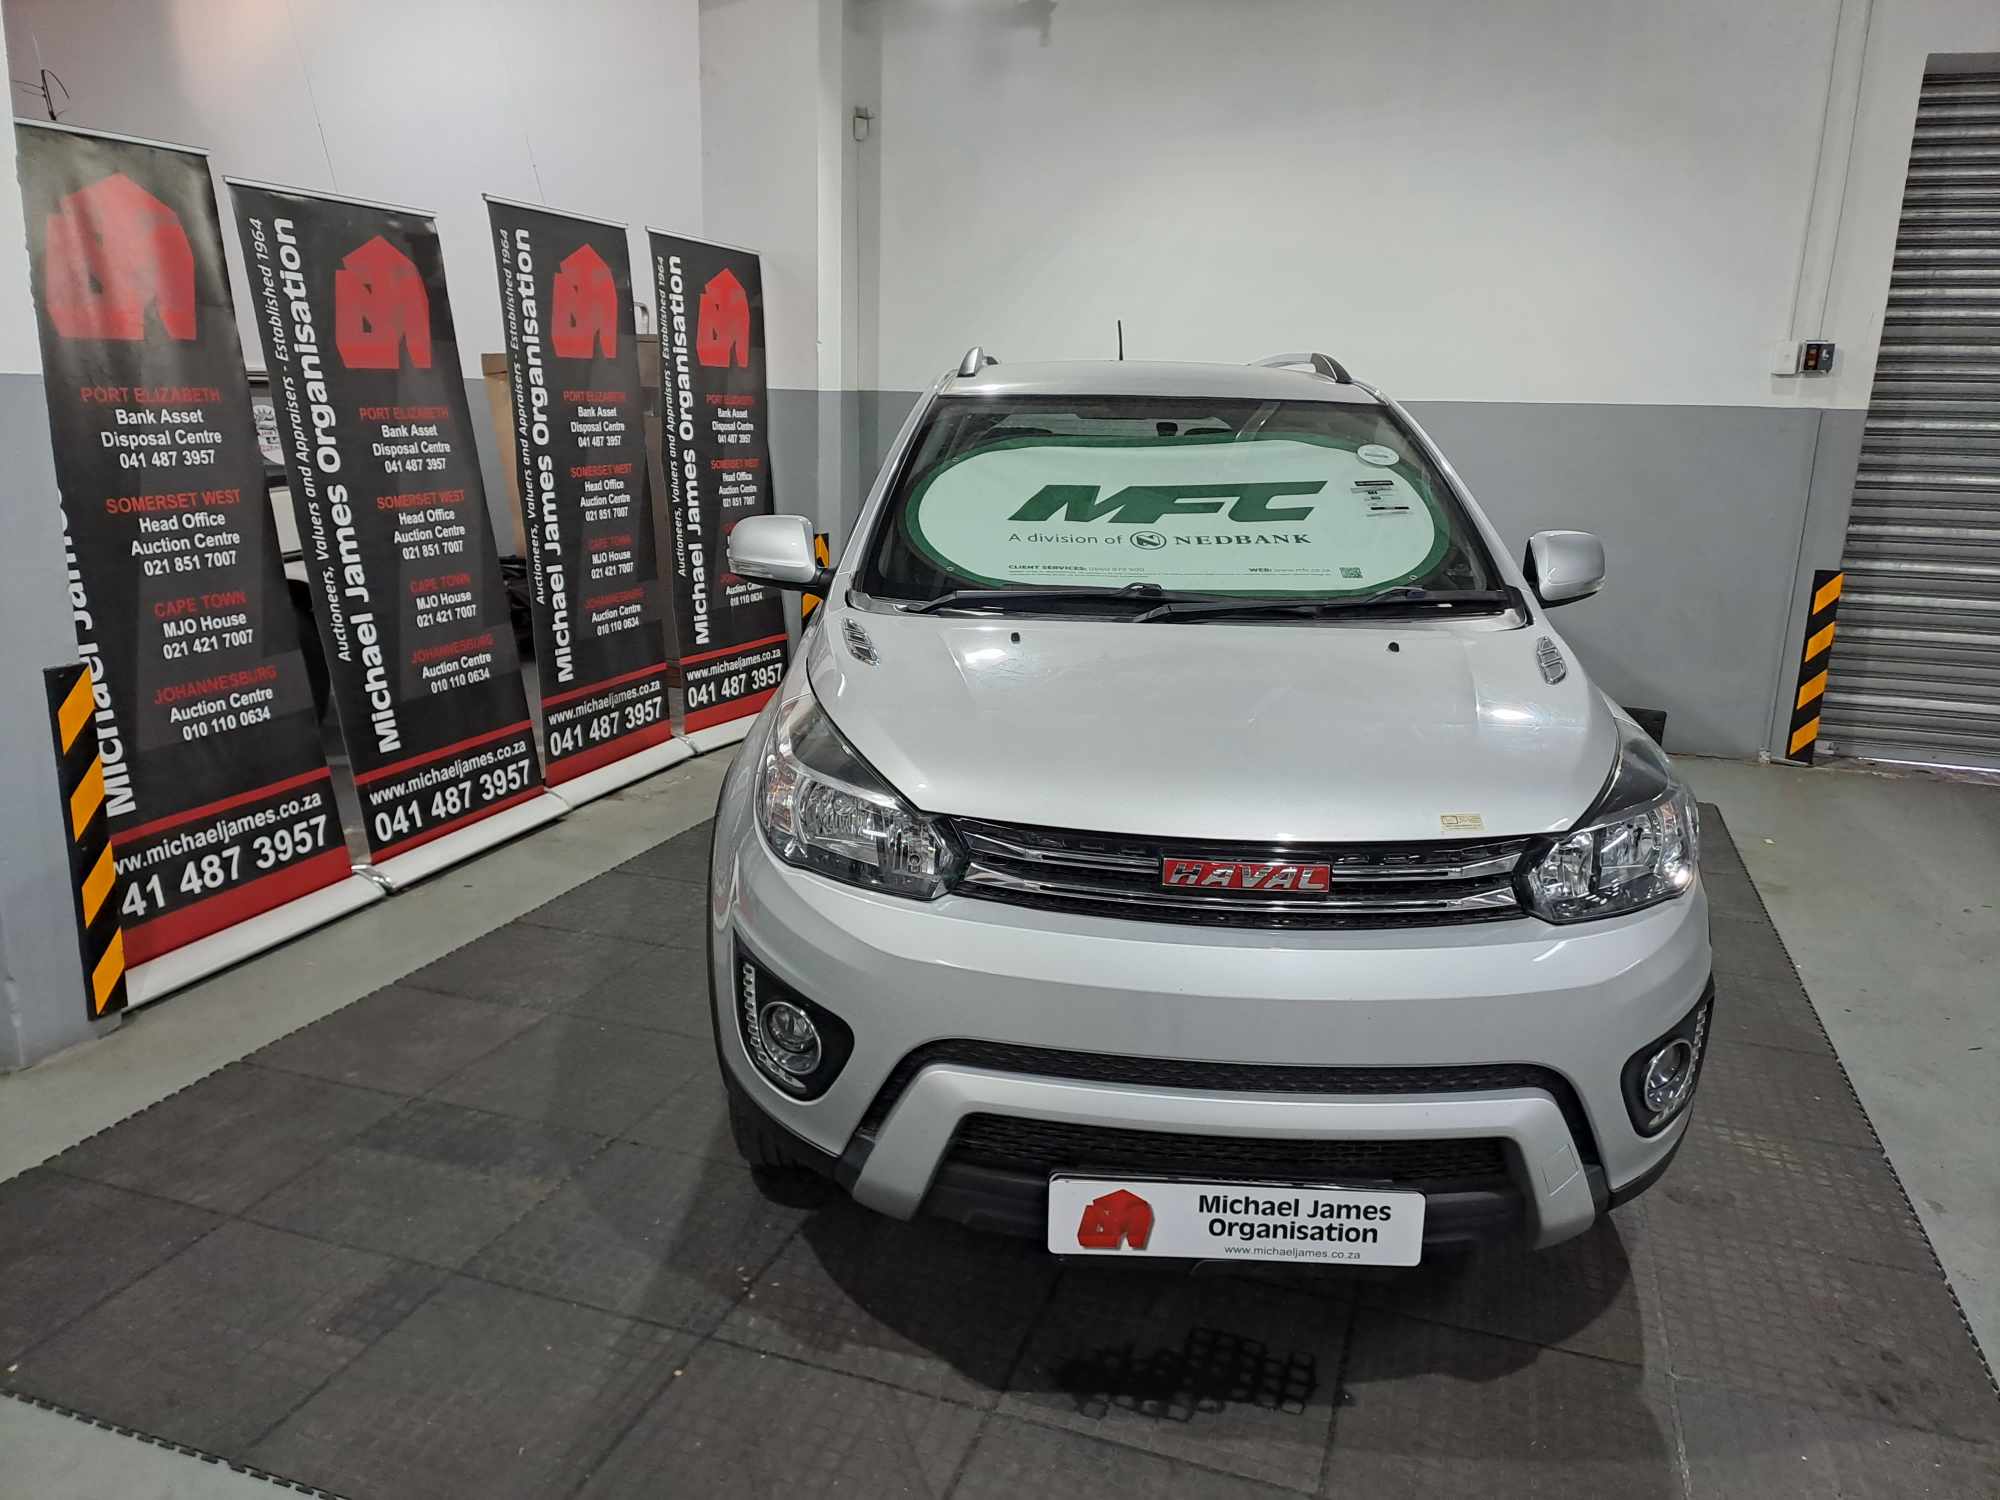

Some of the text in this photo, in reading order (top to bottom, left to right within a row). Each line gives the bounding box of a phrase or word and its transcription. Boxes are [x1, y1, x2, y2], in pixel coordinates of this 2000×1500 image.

[80, 387, 128, 403] PORT
[116, 409, 203, 425] Bank Asset
[101, 429, 222, 450] Disposal Centre
[249, 217, 352, 661] Auctioneers, Valuers and Appraisers Established 1964
[382, 424, 437, 438] Bank Asset
[120, 450, 216, 469] 041 487 3957
[372, 441, 450, 457] Disposal Centre
[515, 229, 574, 683] Michael James Organisation
[669, 256, 710, 645] Michael James Organisation
[385, 458, 446, 473] 041 487 3957
[274, 218, 401, 754] Michael James Organisation
[106, 489, 240, 514] SOMERSET WEST
[1007, 480, 1328, 524] MFC
[139, 512, 225, 534] Head Office
[399, 508, 455, 526] Head Office
[131, 532, 240, 557] Auction Centre
[394, 524, 465, 545] Auction Centre
[1008, 532, 1312, 546] A division of NEDBANK
[402, 540, 464, 560] 021 851 7007
[143, 551, 237, 576] 021 851 7007
[154, 592, 247, 619] CAPE TOWN
[416, 590, 472, 611] MJO House
[163, 613, 247, 639] MJO House
[416, 604, 477, 629] 021 421 7007
[163, 629, 254, 660] 021 421 7007
[422, 653, 492, 679] Auction Centre
[154, 665, 277, 705] JOHANNESBURG
[431, 668, 490, 694] 010 110 0634
[688, 663, 783, 708] 041 487 3957
[169, 687, 274, 723] Auction Centre
[182, 706, 271, 742] 010 110 0634
[550, 696, 662, 756] 041 487 3957
[369, 739, 526, 806] www.michaeljames.co.za
[375, 759, 531, 842] 041 487 3957
[121, 815, 327, 917] 41 487 3957
[1169, 863, 1327, 890] HAVAL
[1198, 1195, 1392, 1222] Michael James
[1208, 1217, 1378, 1243] Organisation
